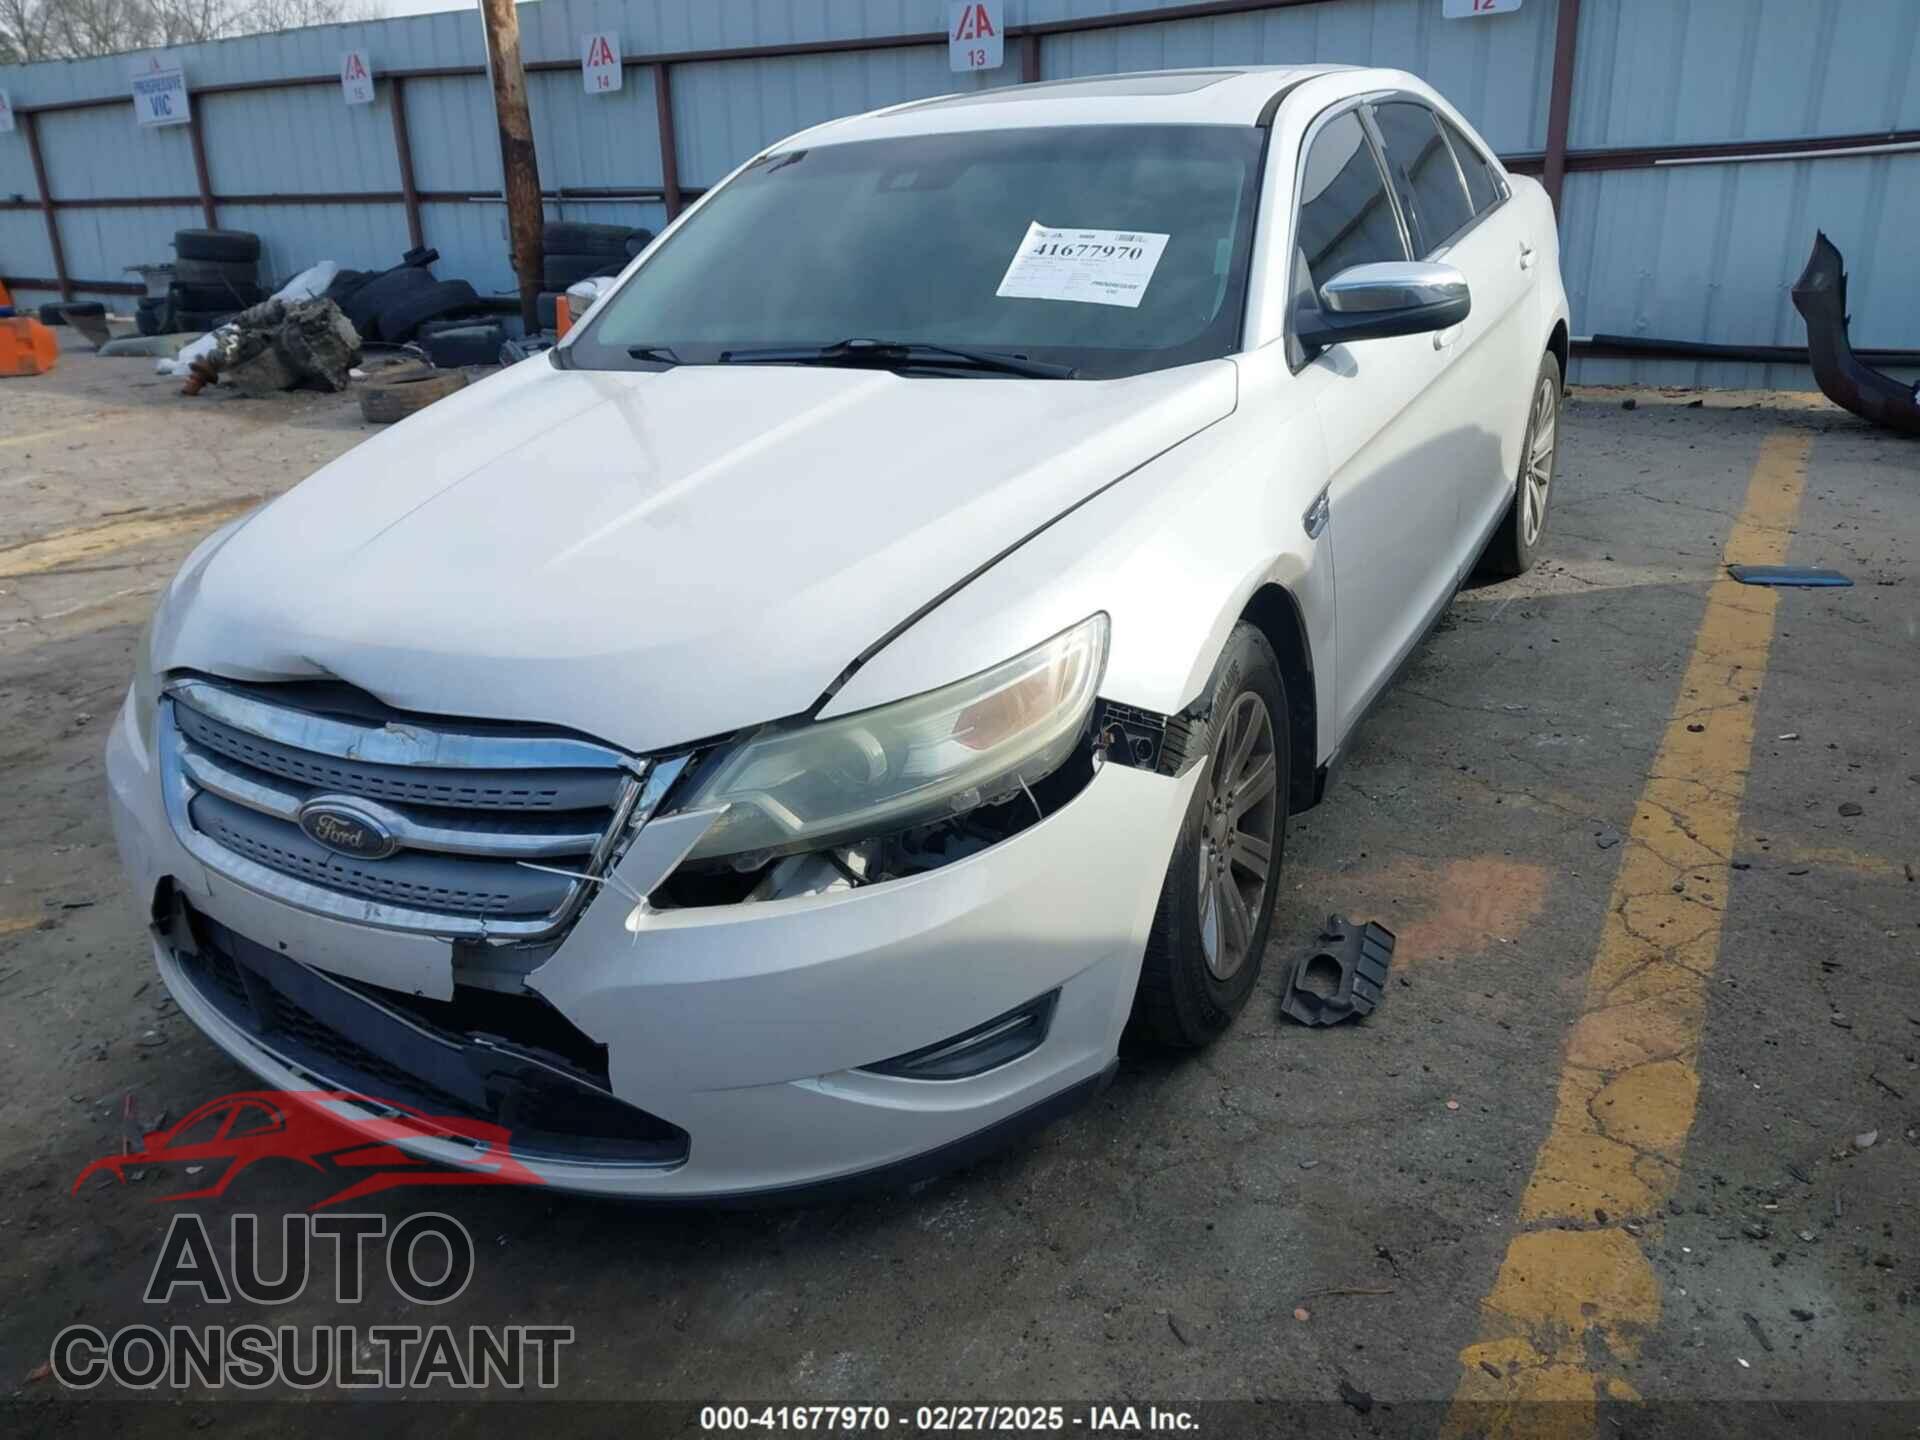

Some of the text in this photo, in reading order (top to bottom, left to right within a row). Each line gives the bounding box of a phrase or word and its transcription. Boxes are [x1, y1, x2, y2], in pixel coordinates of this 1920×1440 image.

[967, 49, 985, 66] 13
[597, 74, 609, 89] 14
[150, 94, 173, 117] VIC
[1033, 242, 1144, 261] 41677970
[316, 814, 364, 848] Ford
